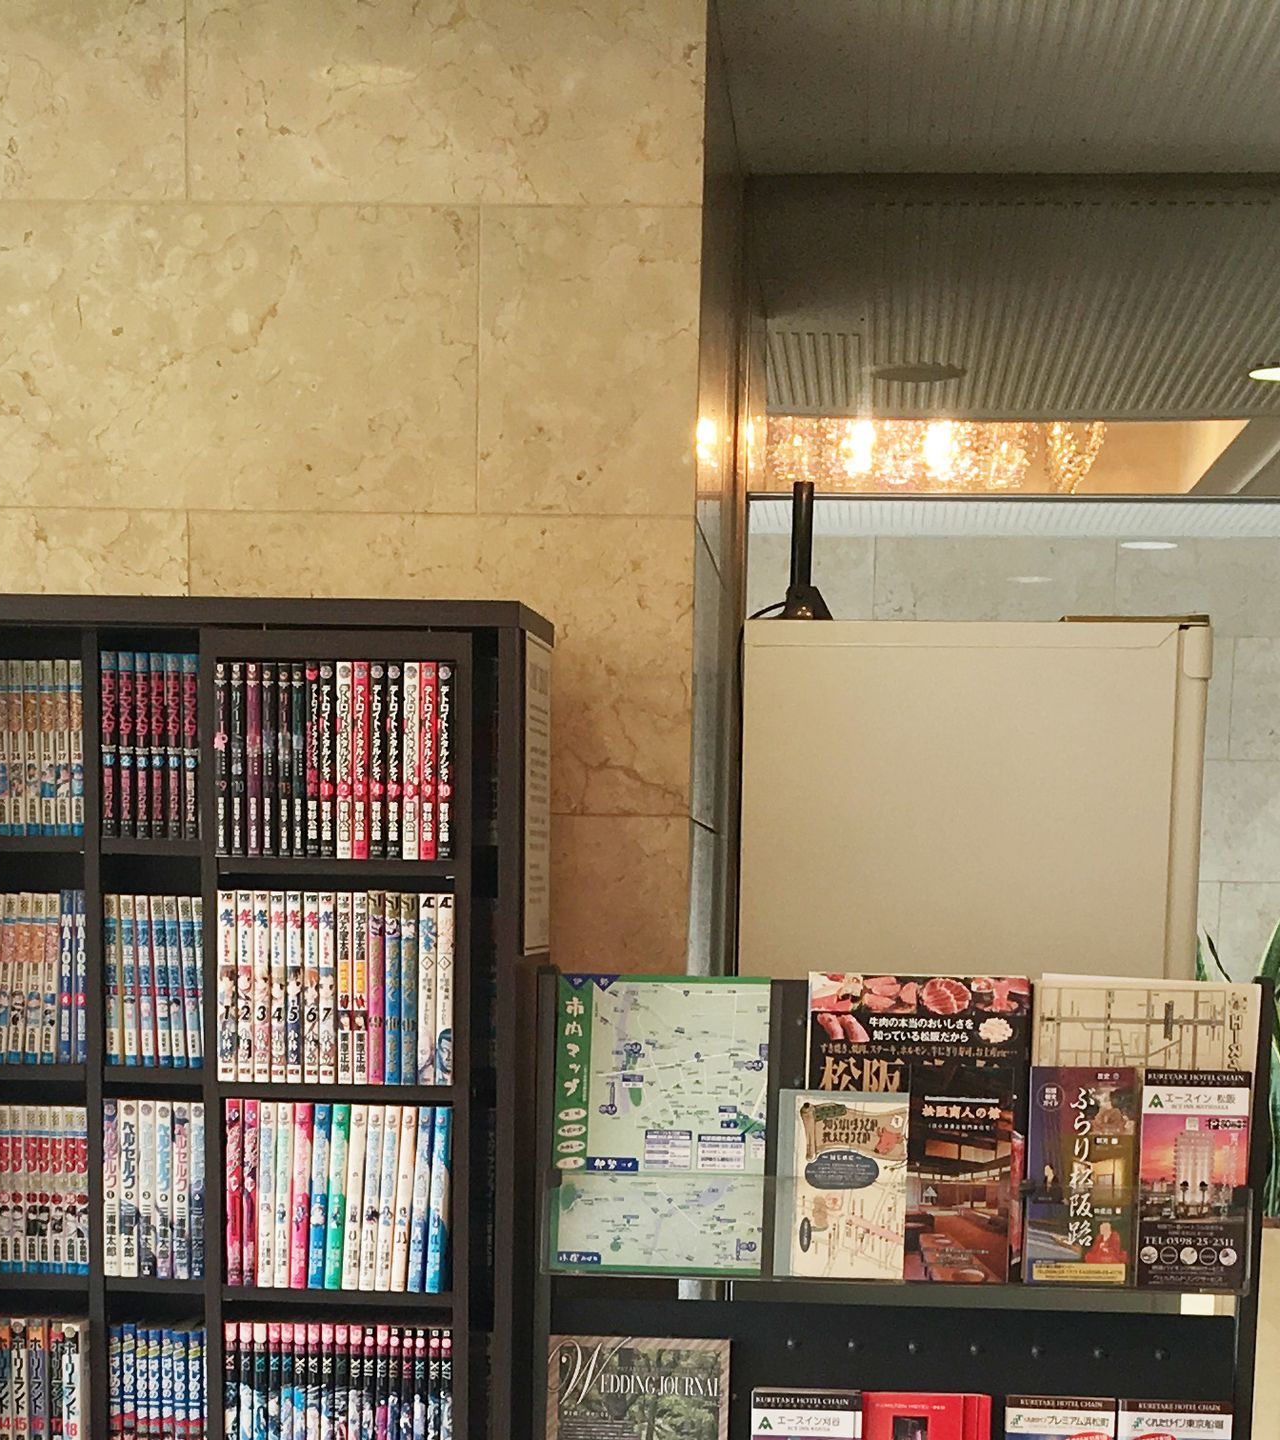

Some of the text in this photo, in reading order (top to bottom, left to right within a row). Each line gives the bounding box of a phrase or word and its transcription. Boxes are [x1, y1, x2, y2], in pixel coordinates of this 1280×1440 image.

[62, 914, 72, 977] MAJOR
[76, 914, 86, 976] MAJOR
[223, 1005, 230, 1020] 1
[241, 1005, 251, 1020] 2
[257, 1005, 267, 1020] 3
[289, 1004, 299, 1022] 5
[322, 1007, 332, 1022] 7
[869, 1016, 974, 1031] 牛肉の本当のおいしさを
[564, 996, 586, 1098] 市内マップ
[872, 1030, 970, 1043] 知っている松阪だから
[1165, 1093, 1213, 1103] エースイン
[104, 1120, 118, 1189] ベルセルク
[122, 1121, 136, 1190] ベルセルク
[174, 1124, 188, 1192] ベルセルク
[1066, 1086, 1096, 1248] ぶらり松阪路
[12, 1338, 27, 1430] ホーリーランド 15
[63, 1340, 78, 1436] ホーリーランド 18
[547, 1336, 723, 1405] WEDDING JOURNAL
[0, 1418, 11, 1429] 14
[777, 1415, 840, 1427] エースイン刈谷
